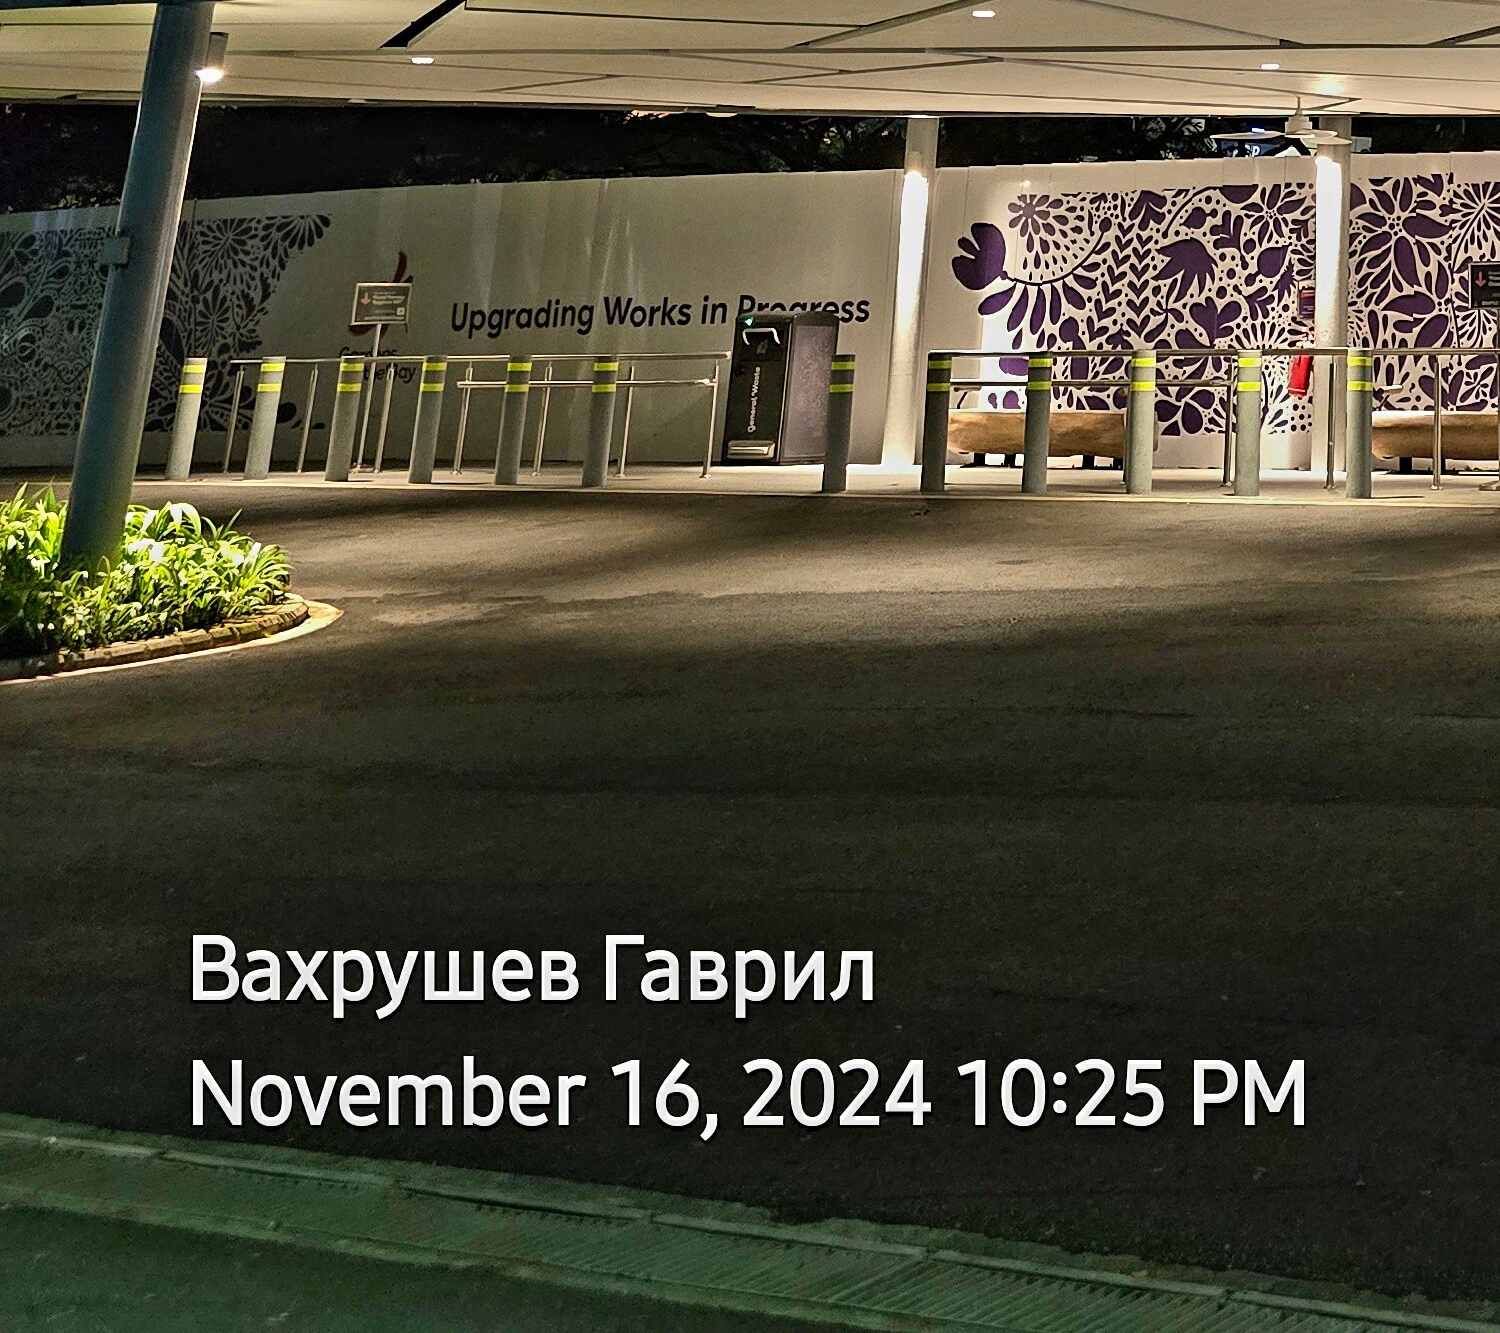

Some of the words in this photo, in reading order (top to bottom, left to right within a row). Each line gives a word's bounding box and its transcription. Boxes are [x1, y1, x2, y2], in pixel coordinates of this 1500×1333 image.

[451, 299, 594, 339] Upgrading
[603, 296, 692, 327] Works
[701, 295, 728, 324] in
